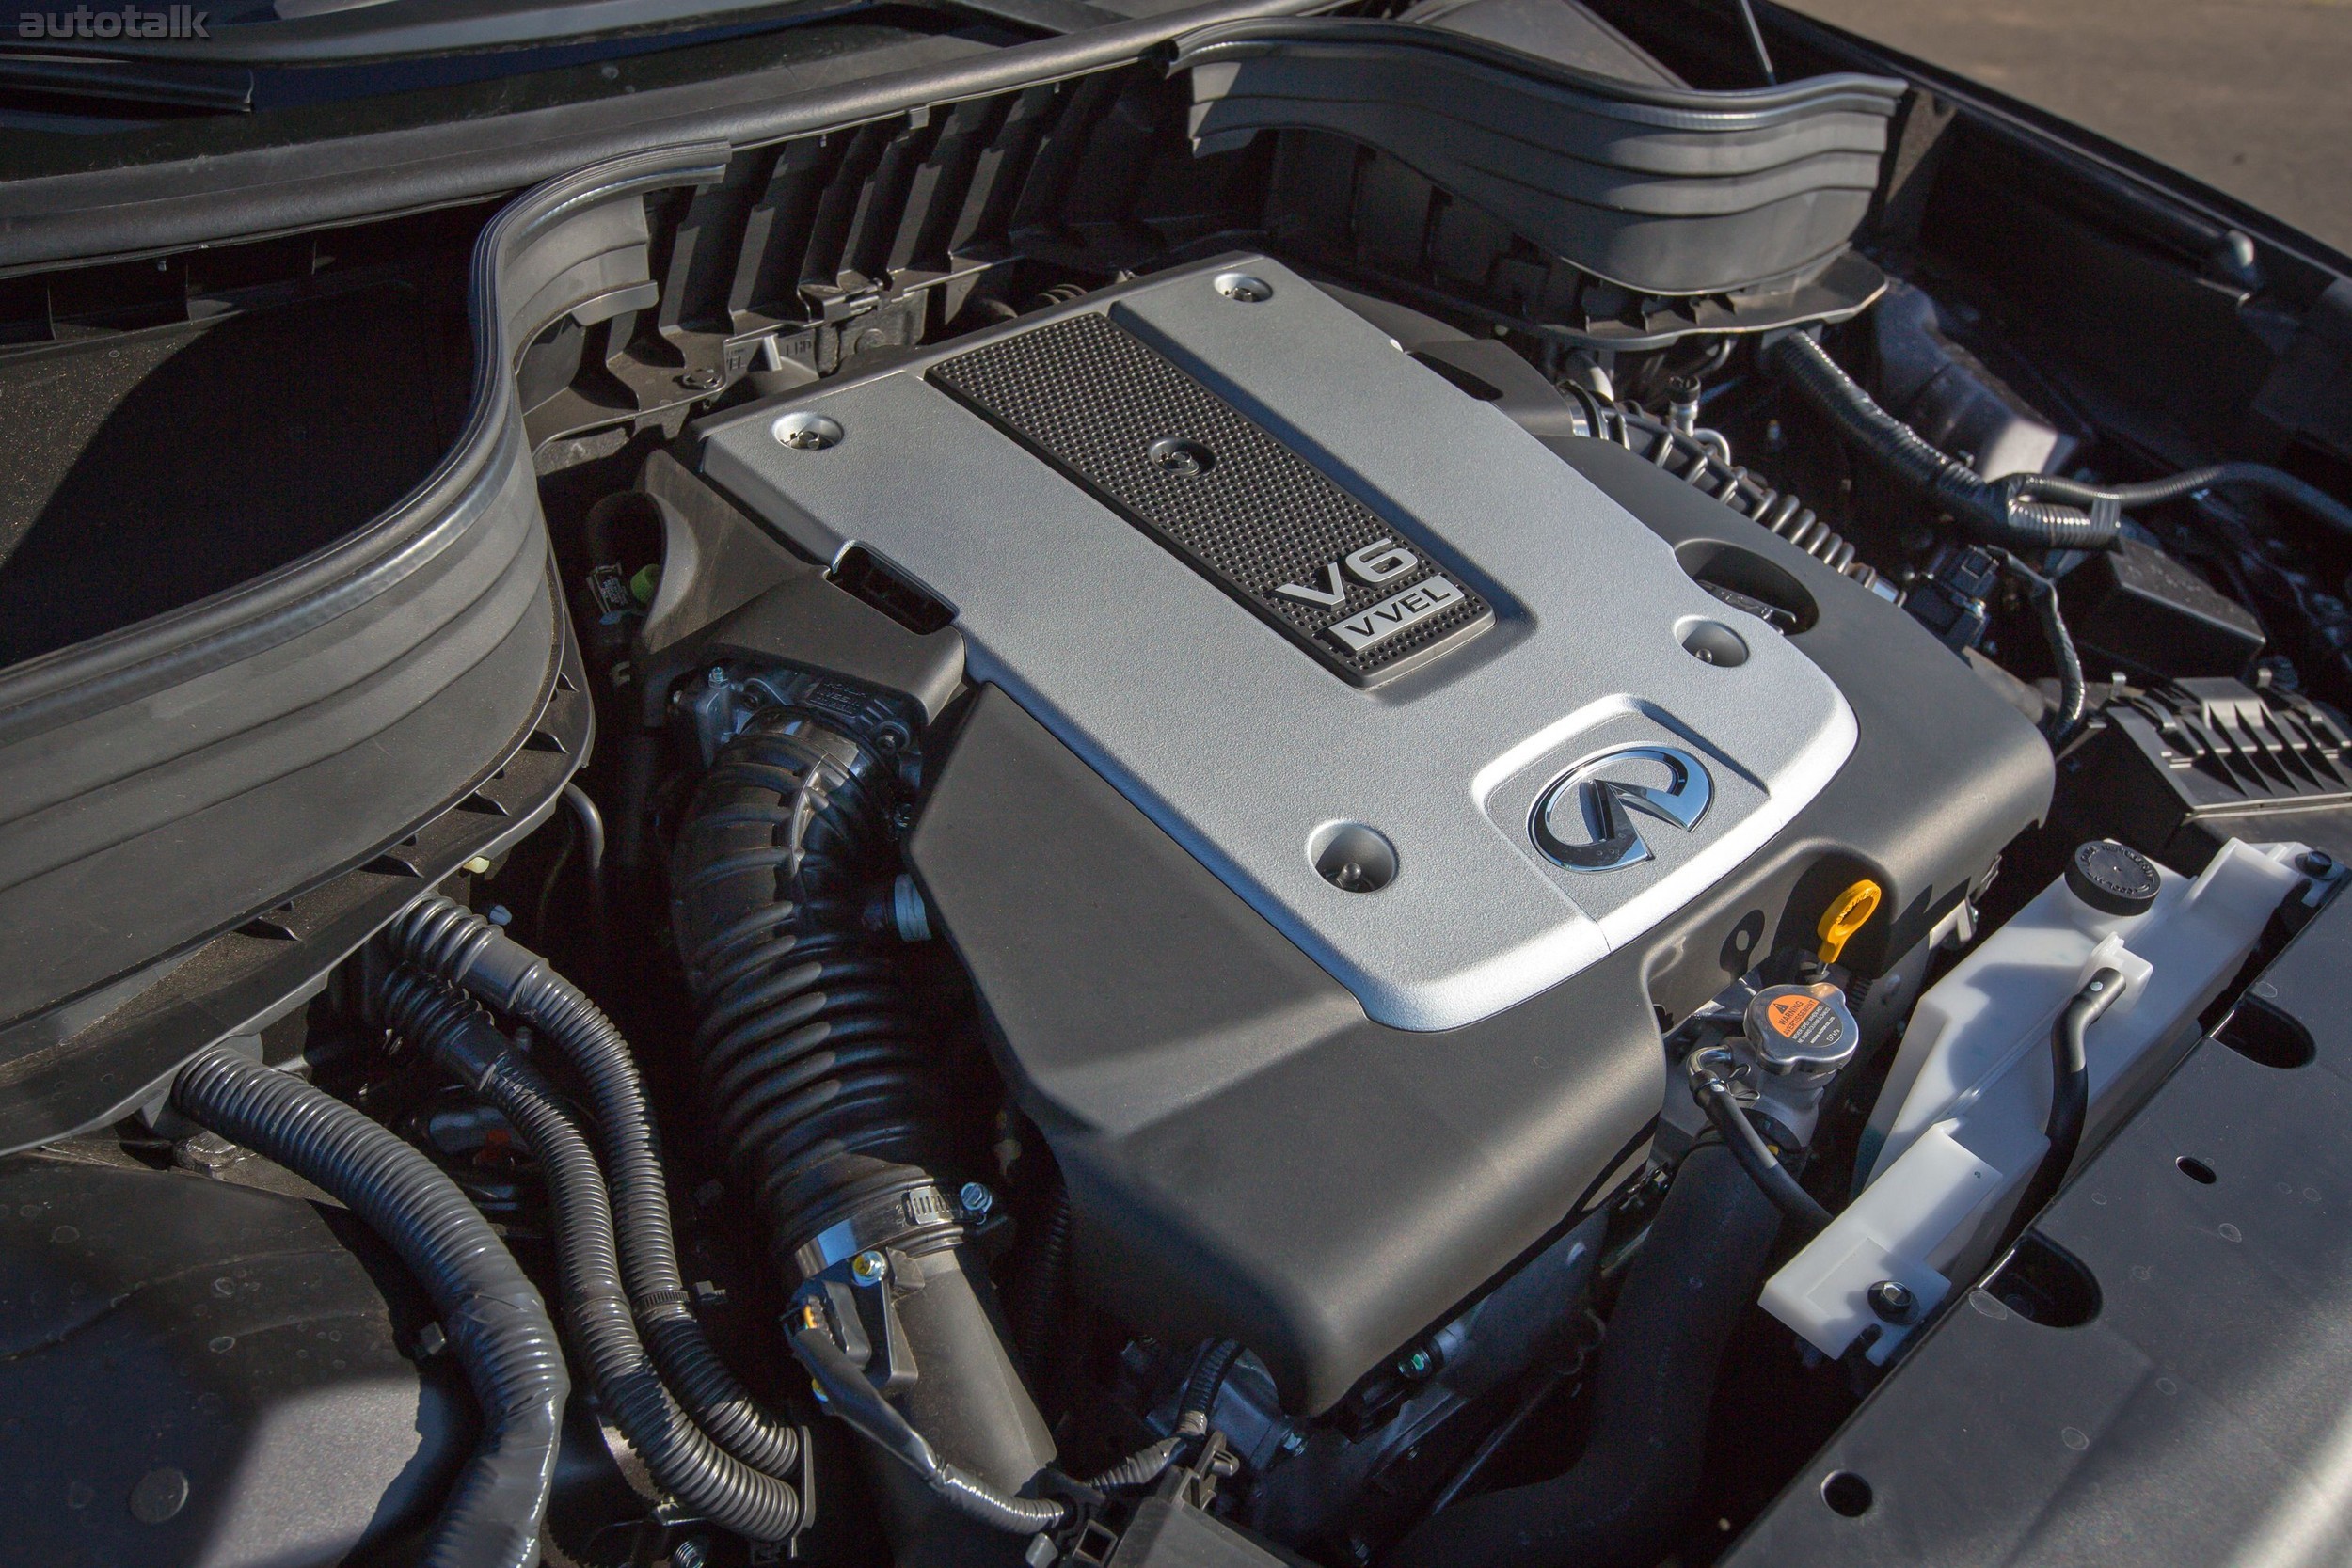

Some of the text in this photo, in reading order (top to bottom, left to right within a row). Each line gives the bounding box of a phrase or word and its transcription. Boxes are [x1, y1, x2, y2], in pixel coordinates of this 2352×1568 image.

[1275, 538, 1418, 611] V6
[1344, 587, 1450, 637] VVEL
[1778, 1001, 1804, 1025] WARNING
[1783, 999, 1816, 1035] AVERTISSEMENT
